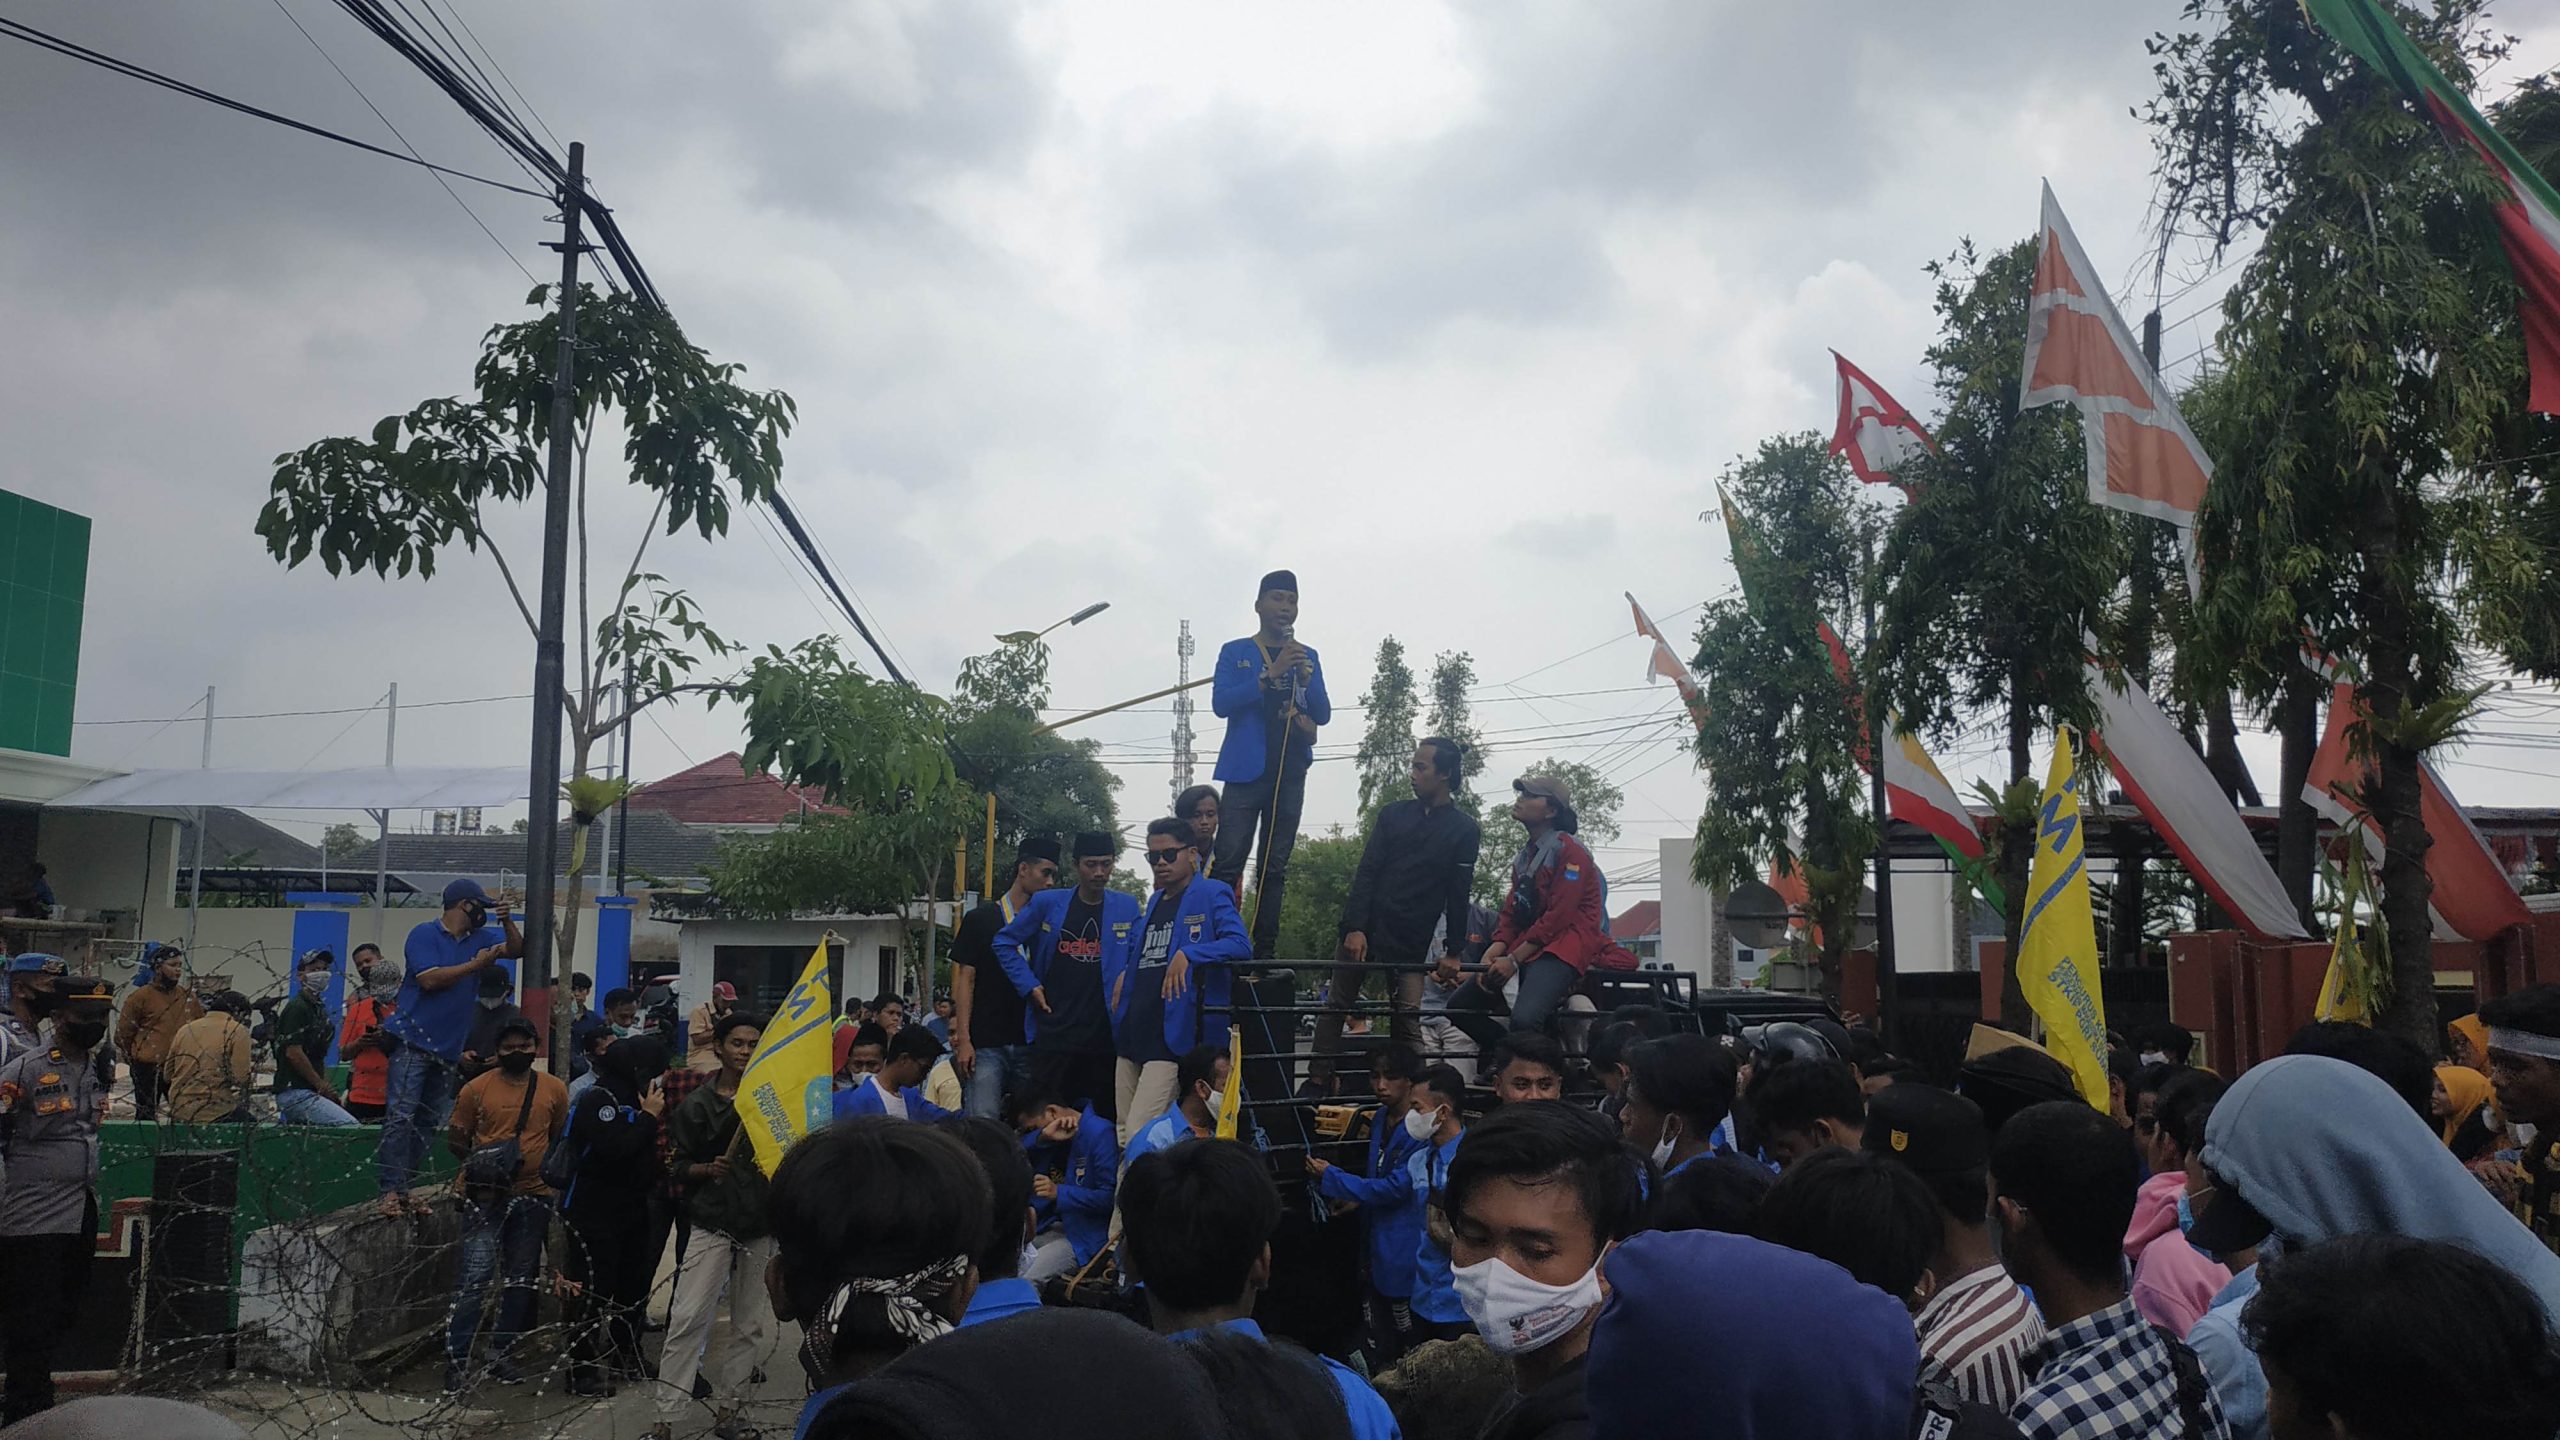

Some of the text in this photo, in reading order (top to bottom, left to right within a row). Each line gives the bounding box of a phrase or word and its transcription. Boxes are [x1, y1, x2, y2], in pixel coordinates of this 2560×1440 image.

[752, 1089, 771, 1117] STKIP
[768, 1119, 785, 1143] PGRI
[763, 1081, 793, 1130] PENGURUS
